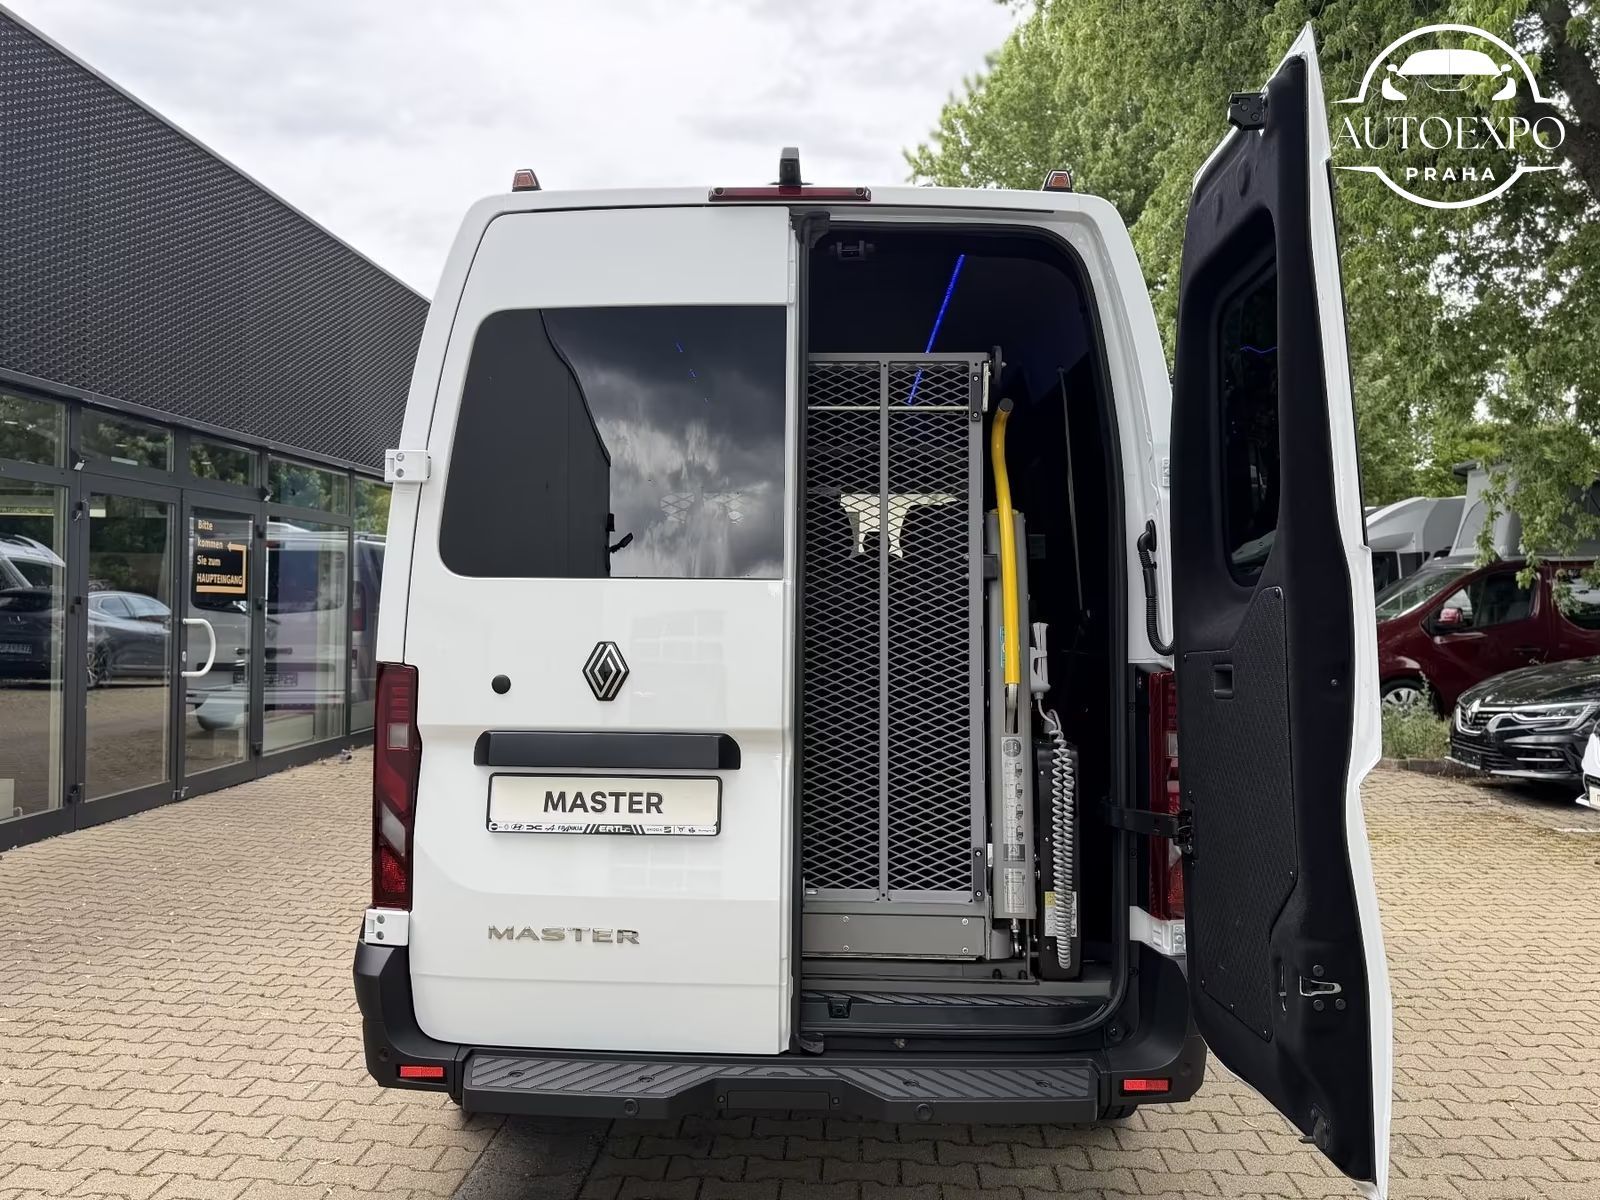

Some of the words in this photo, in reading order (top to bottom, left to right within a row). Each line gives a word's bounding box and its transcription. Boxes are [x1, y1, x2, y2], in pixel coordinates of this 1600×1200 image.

[198, 519, 213, 531] Bitte
[197, 537, 224, 549] kommen
[197, 555, 207, 565] Sie
[208, 558, 221, 566] zum
[196, 573, 243, 585] HAUPTEINGANG
[543, 790, 663, 814] MASTER
[488, 925, 640, 945] MASTER
